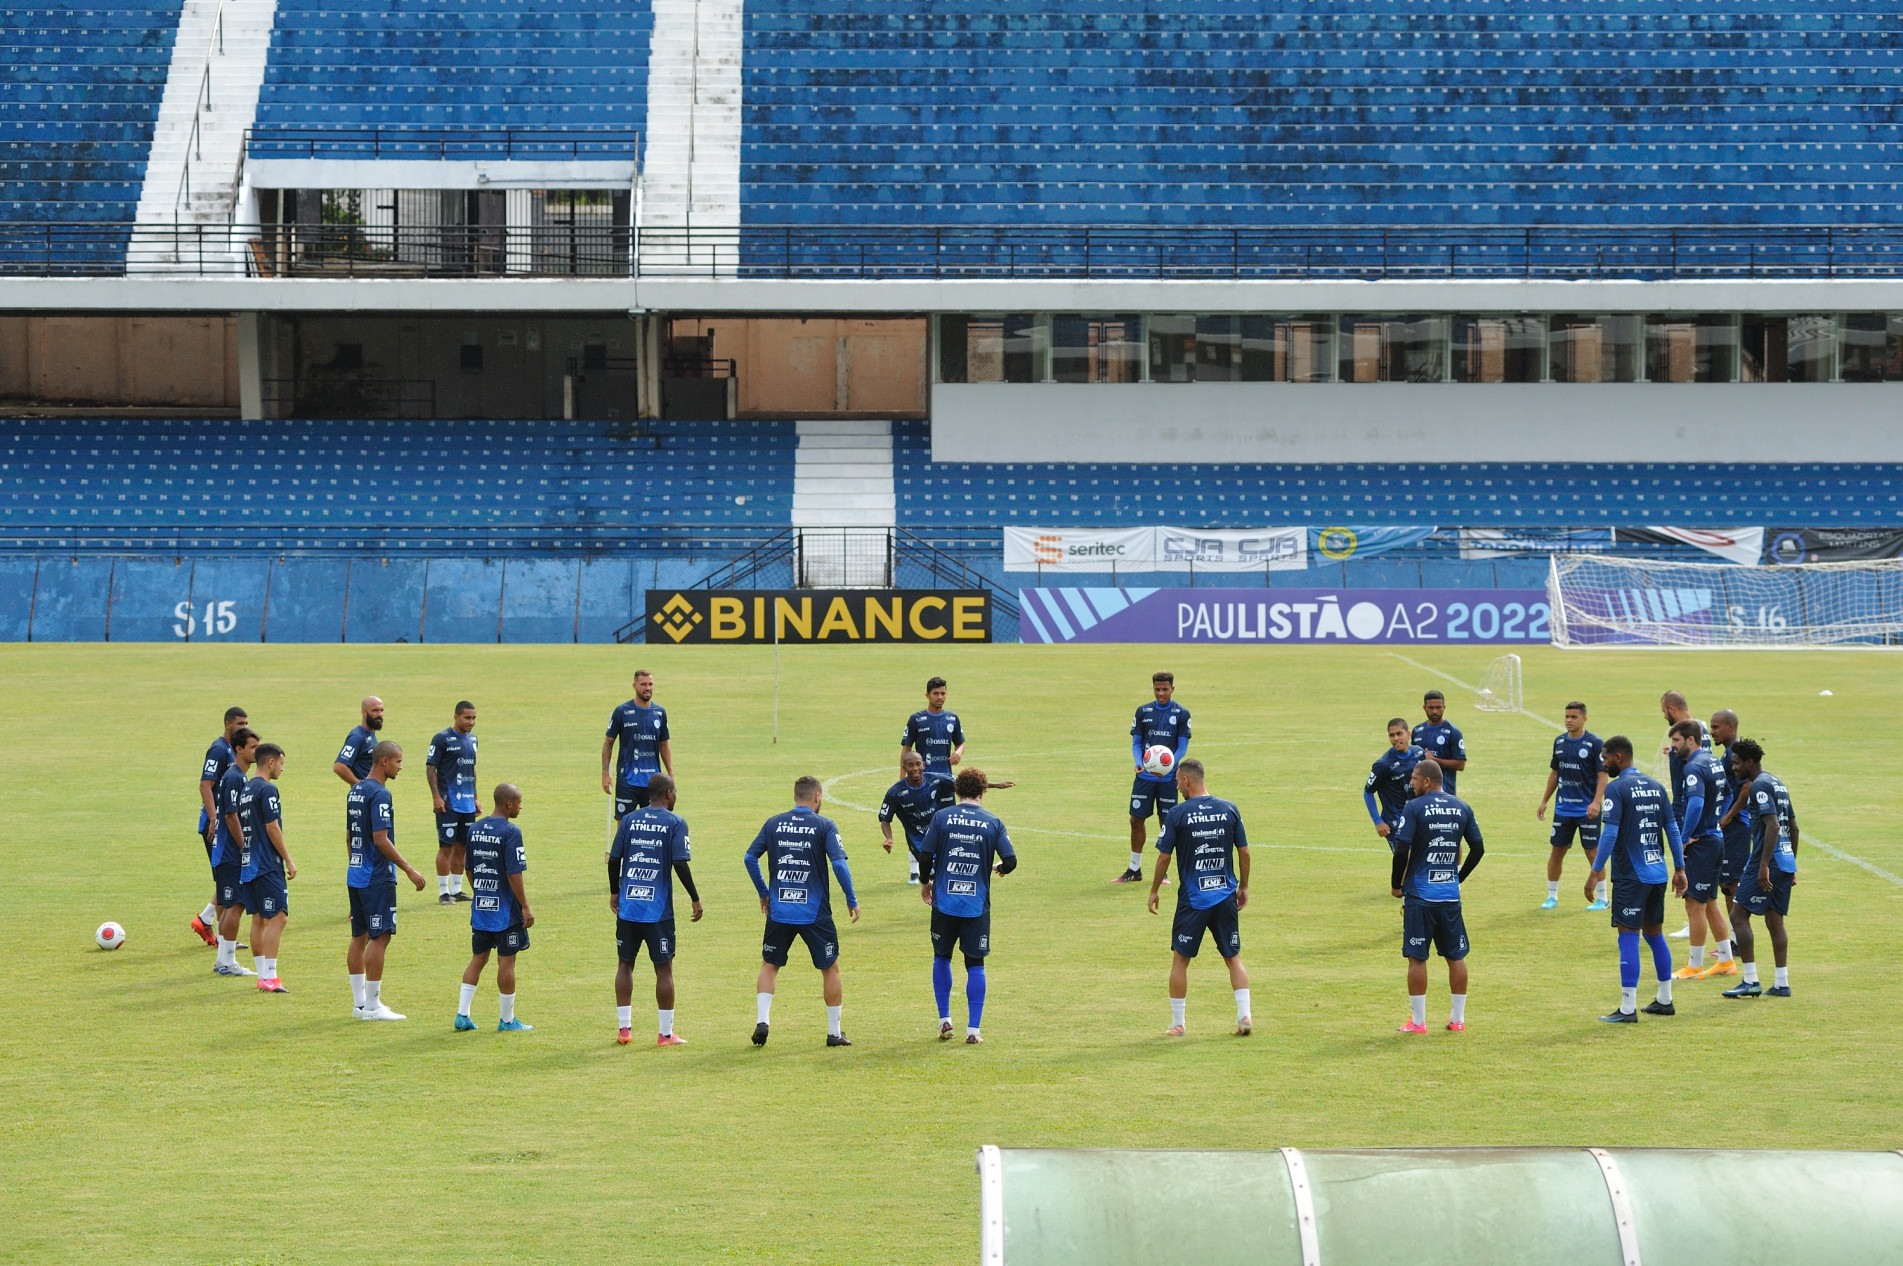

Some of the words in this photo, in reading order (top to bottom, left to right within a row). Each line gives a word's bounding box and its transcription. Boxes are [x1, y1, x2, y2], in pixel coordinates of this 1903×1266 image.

[1069, 542, 1125, 556] seritec
[1238, 554, 1298, 562] SPORTS
[172, 602, 196, 638] S
[203, 600, 236, 636] 15
[710, 596, 986, 640] BINANCE
[1178, 595, 1384, 640] PAULISTÃO
[1386, 602, 1438, 638] A2
[1446, 602, 1550, 639] 2022
[1424, 808, 1462, 816] ATHLETA
[947, 818, 987, 828] ATHLETA
[1187, 814, 1226, 824] ATHLETA
[630, 823, 667, 833] ATHLETA
[776, 826, 814, 834] ATHLETA
[471, 834, 500, 844] ATHLETA
